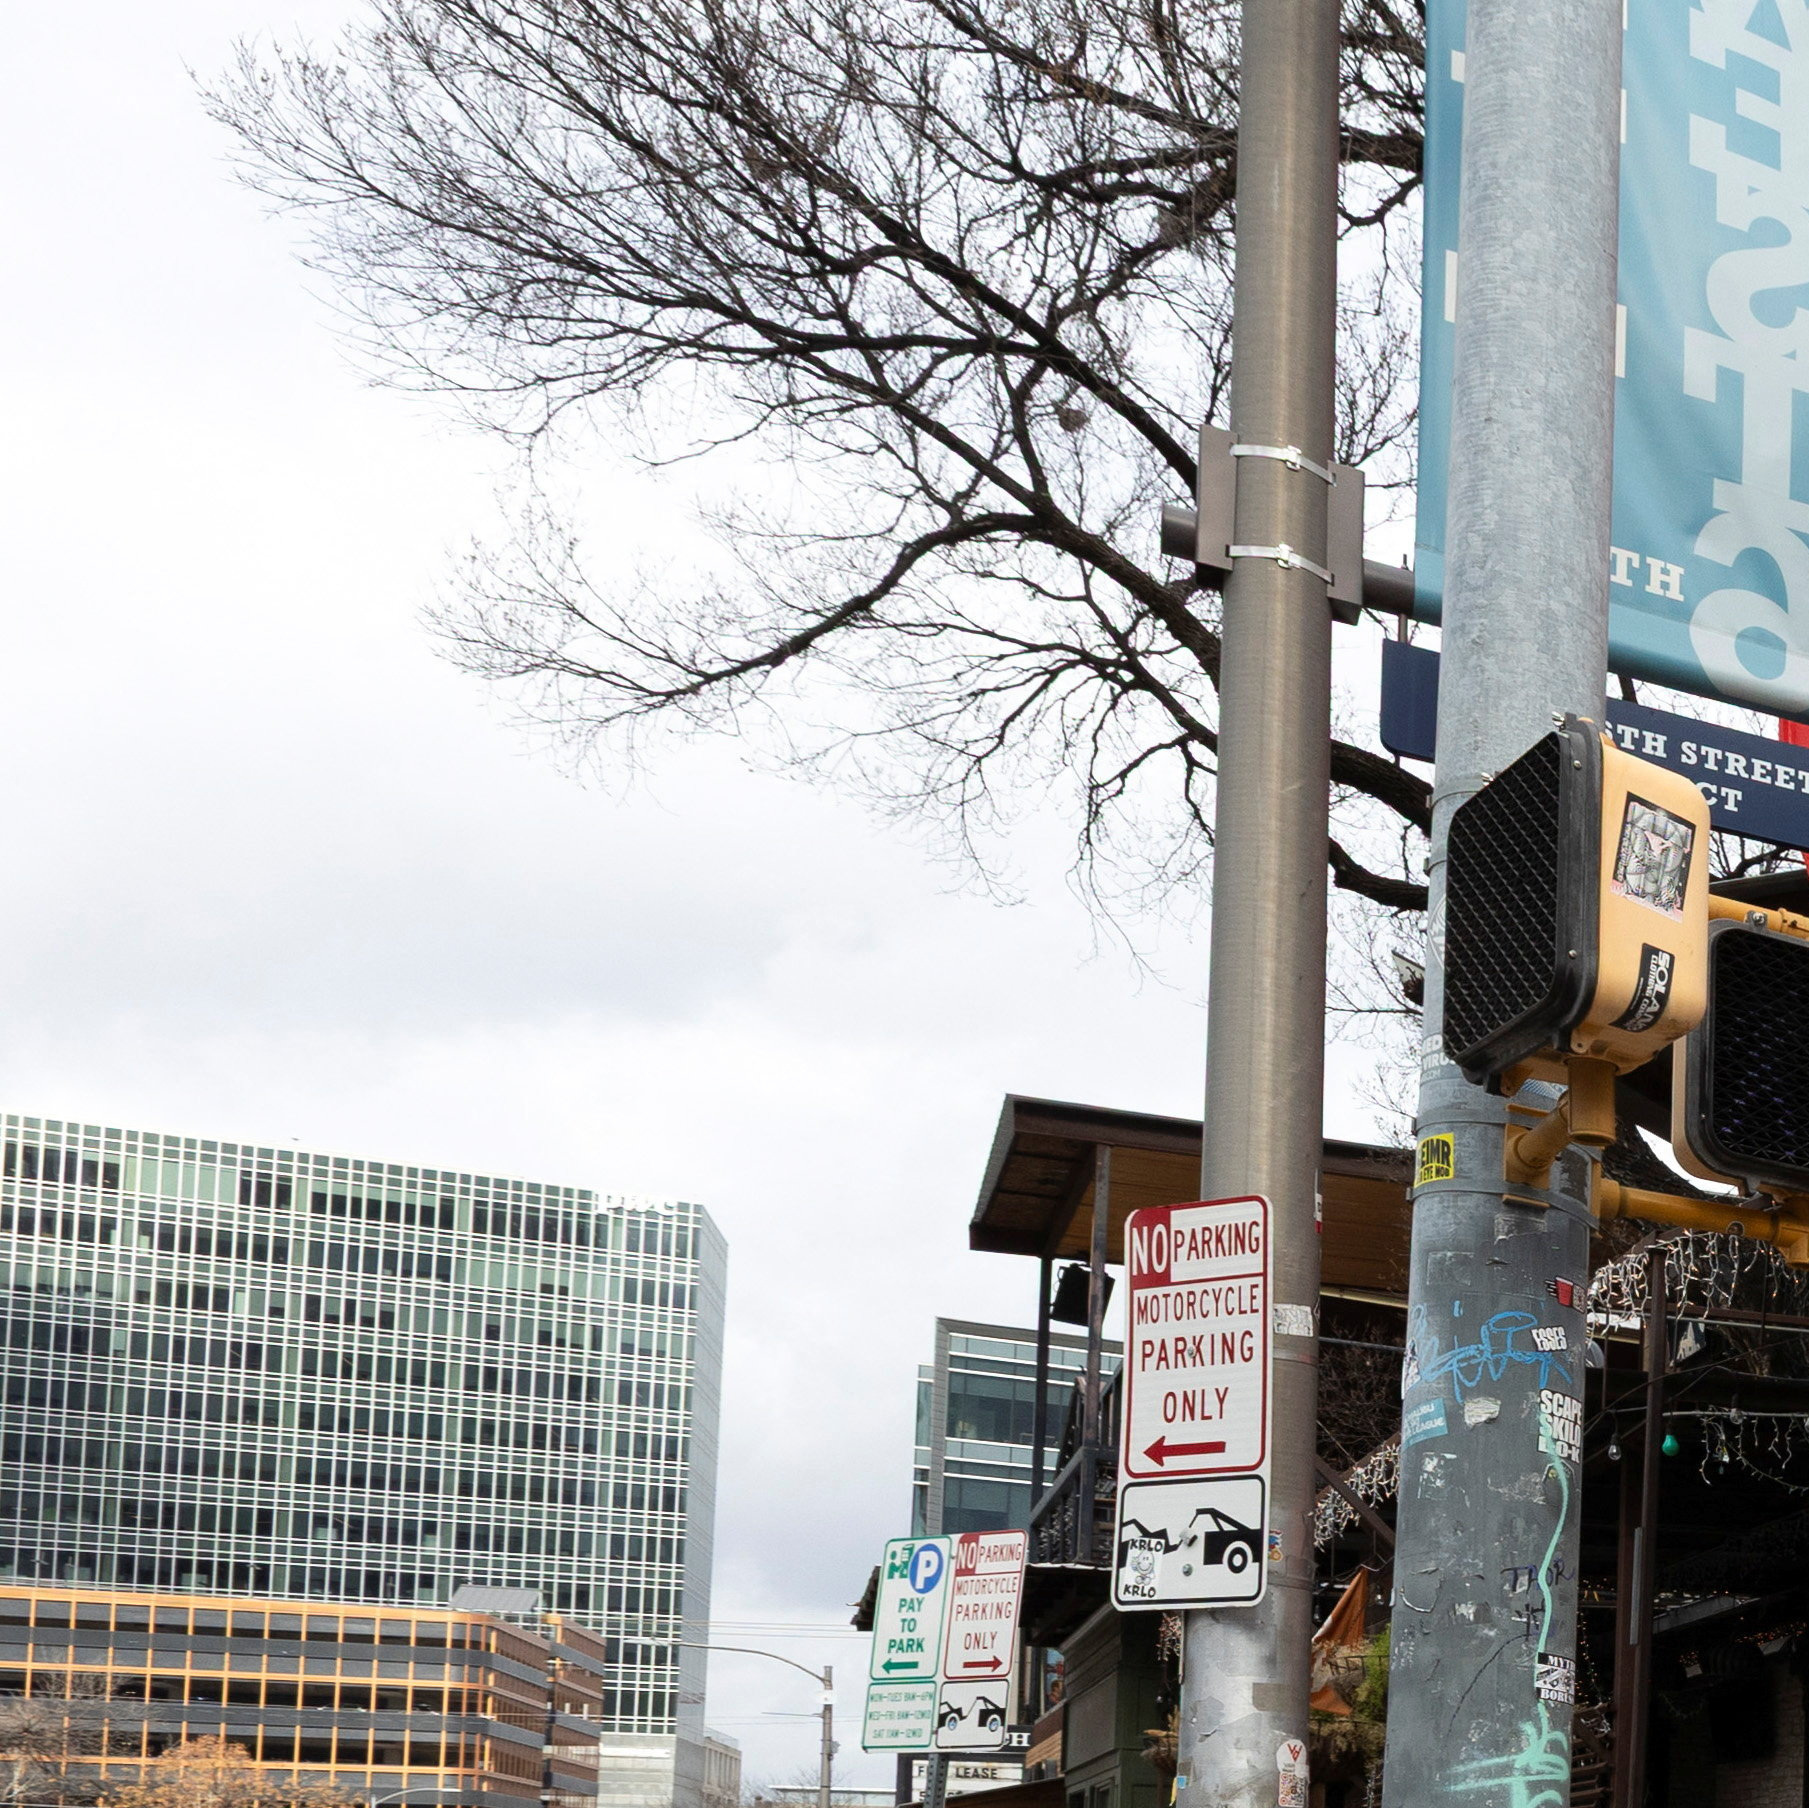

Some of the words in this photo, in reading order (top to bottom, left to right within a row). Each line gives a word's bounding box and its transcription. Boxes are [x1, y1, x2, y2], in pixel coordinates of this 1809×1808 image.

[1606, 717, 1667, 760] TH
[1131, 1222, 1168, 1277] NO
[1173, 1219, 1261, 1263] PARKING
[1136, 1283, 1260, 1326] MOTORCYCLE
[1141, 1329, 1255, 1373] PARKING
[1162, 1386, 1230, 1424] ONLY
[956, 1541, 976, 1571] NO
[979, 1542, 1022, 1564] PARKING
[956, 1576, 1017, 1597] MOTORCYCLE
[898, 1597, 924, 1613] PAY
[956, 1601, 1012, 1621] PARKING
[900, 1618, 917, 1633] TO
[888, 1638, 924, 1654] PARK
[964, 1632, 998, 1651] ONLY
[956, 1767, 998, 1779] LEASE
